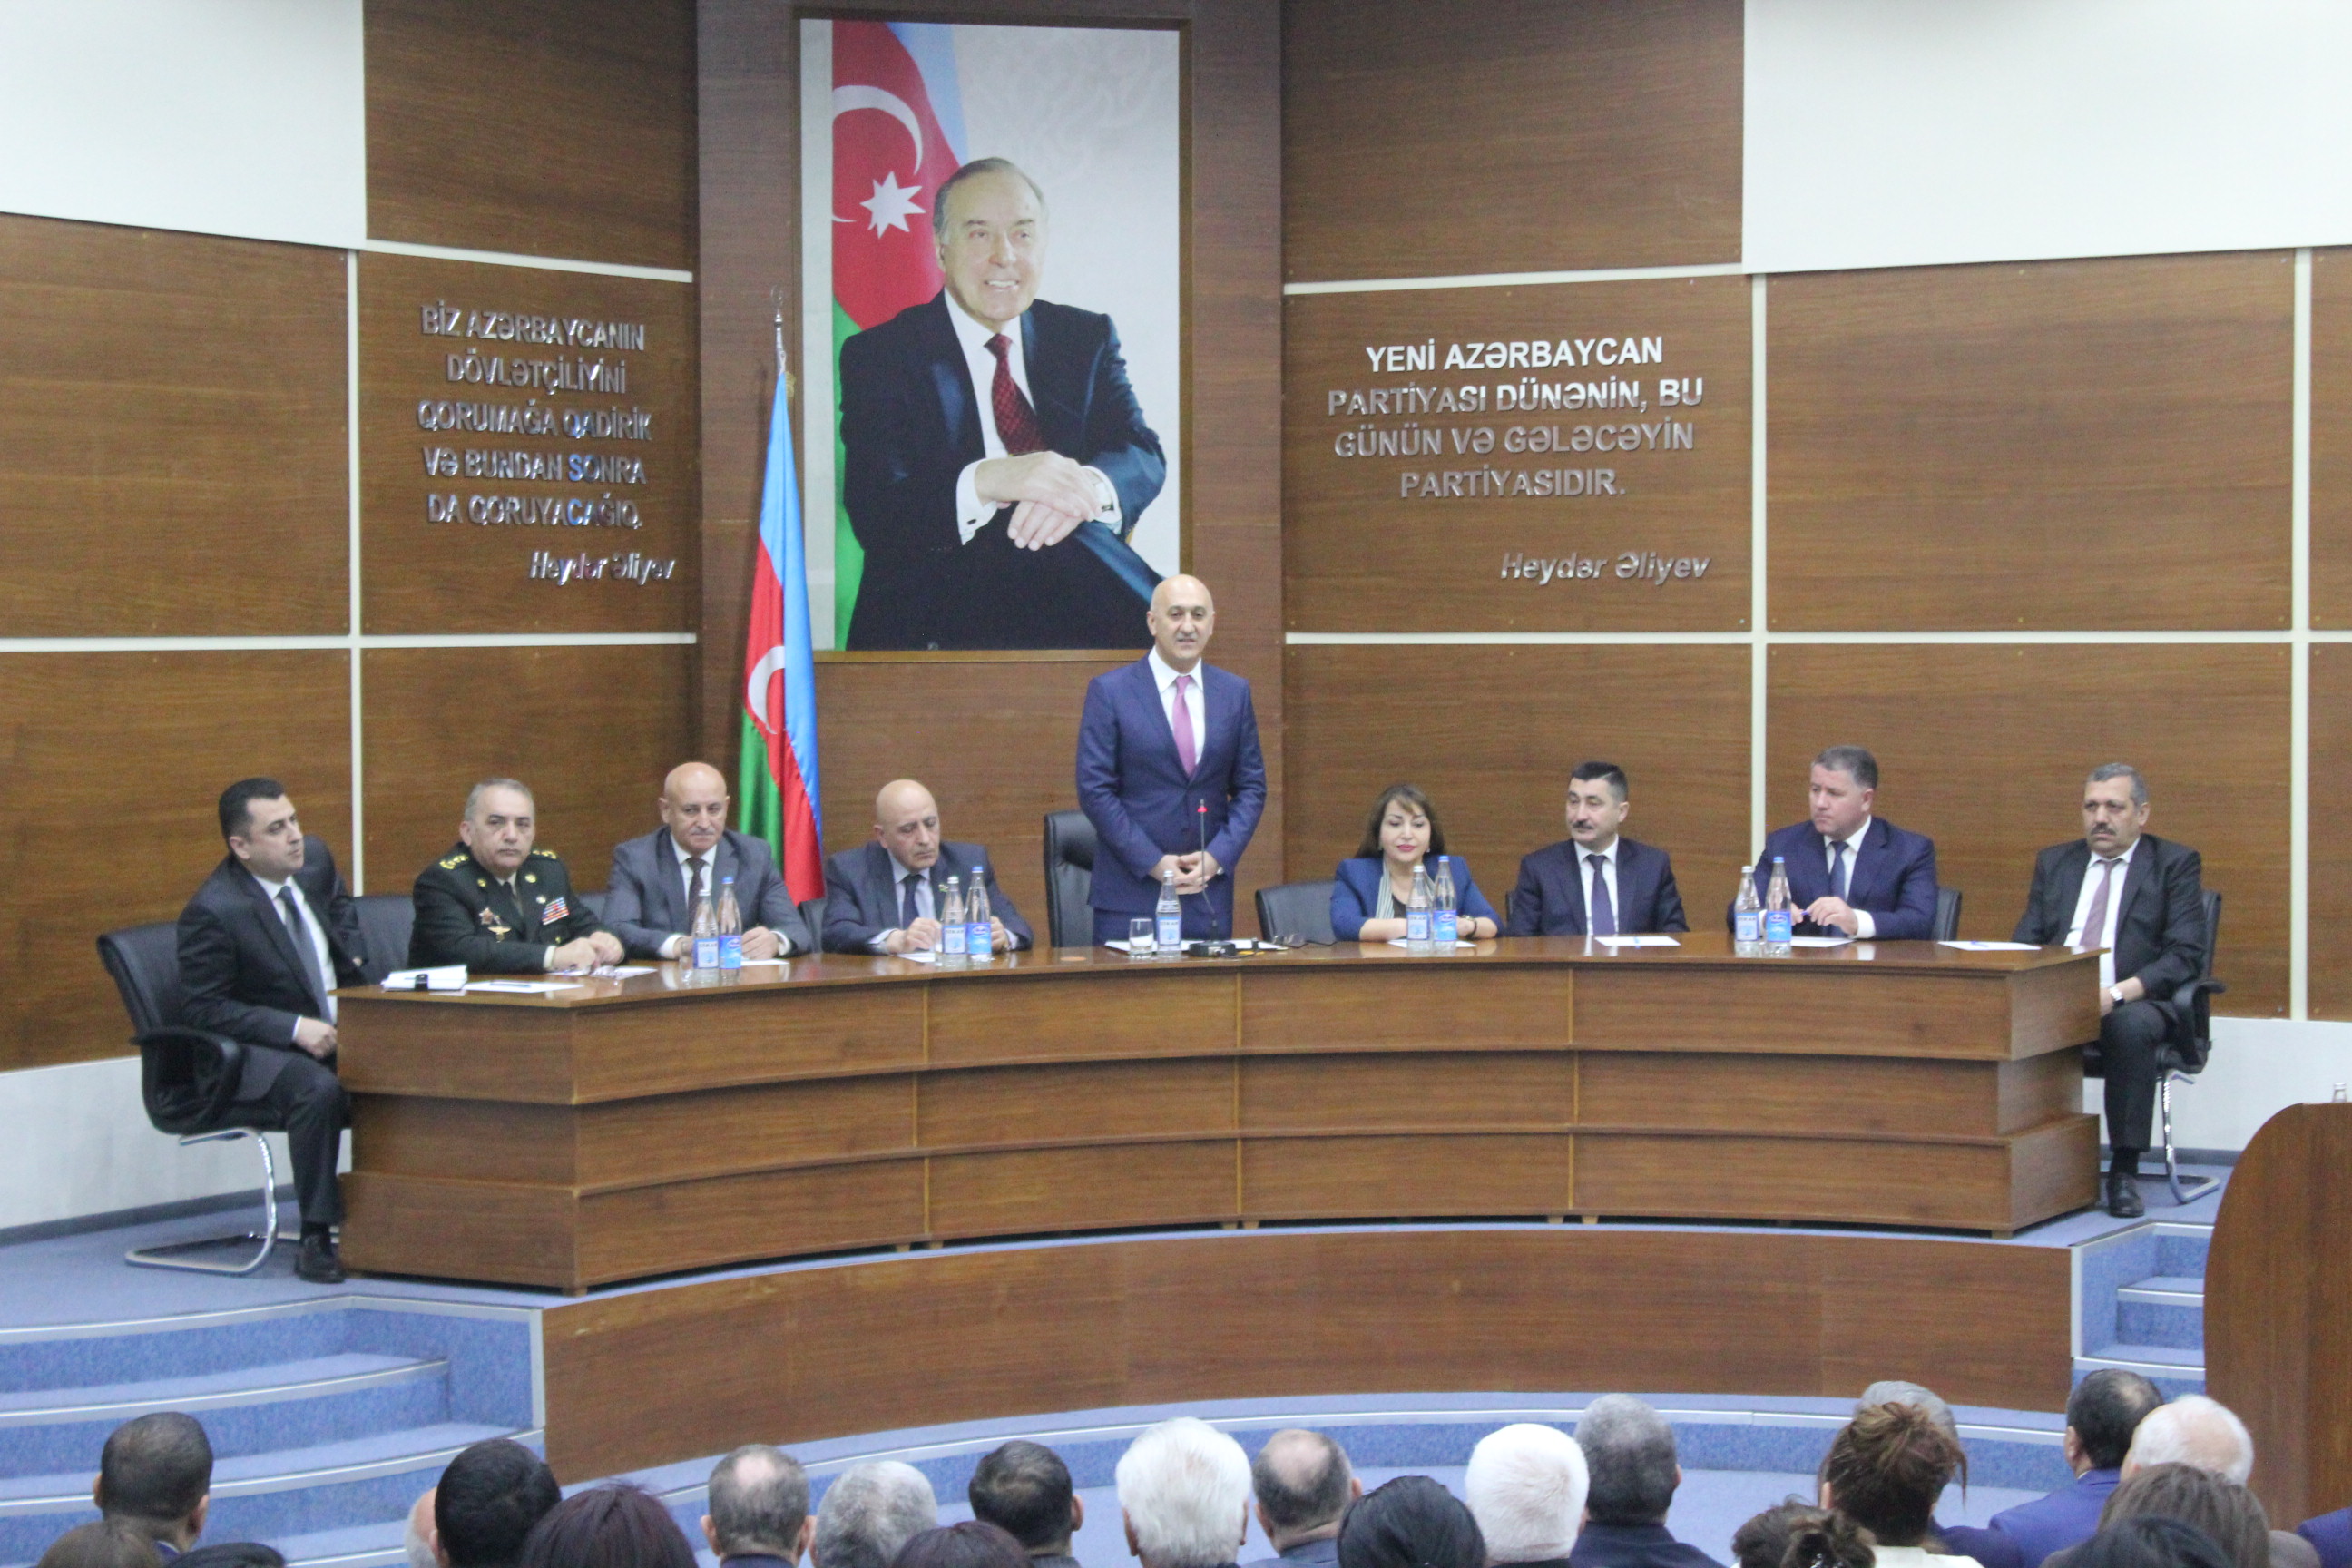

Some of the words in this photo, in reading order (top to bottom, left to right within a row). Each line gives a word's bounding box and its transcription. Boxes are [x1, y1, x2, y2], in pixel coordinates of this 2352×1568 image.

[421, 299, 462, 337] BİZ
[466, 310, 645, 351] AZƏRBAYCANIN
[446, 348, 626, 395] DÖVLƏTÇİLİYİNİ
[1366, 338, 1436, 373] YENİ
[1444, 336, 1663, 372] AZƏRBAYCAN
[1328, 381, 1486, 416] PARTİYASI
[1496, 375, 1647, 414] DÜNƏNİN,
[1658, 377, 1704, 407] BU
[417, 398, 558, 436] QORUMAĞA
[563, 406, 652, 440] QADİRİK
[1334, 422, 1443, 458] GÜNÜN
[1451, 426, 1496, 455] VƏ
[1504, 416, 1694, 454] GƏLƏCƏYİN
[423, 446, 458, 477] VƏ
[465, 448, 563, 482] BUNDAN
[568, 453, 647, 485] SONRA
[1400, 464, 1626, 498] PARTİYASIDIR.
[427, 493, 463, 524] DA
[1500, 552, 1609, 587] Heydər
[1615, 551, 1711, 587] Əliyev
